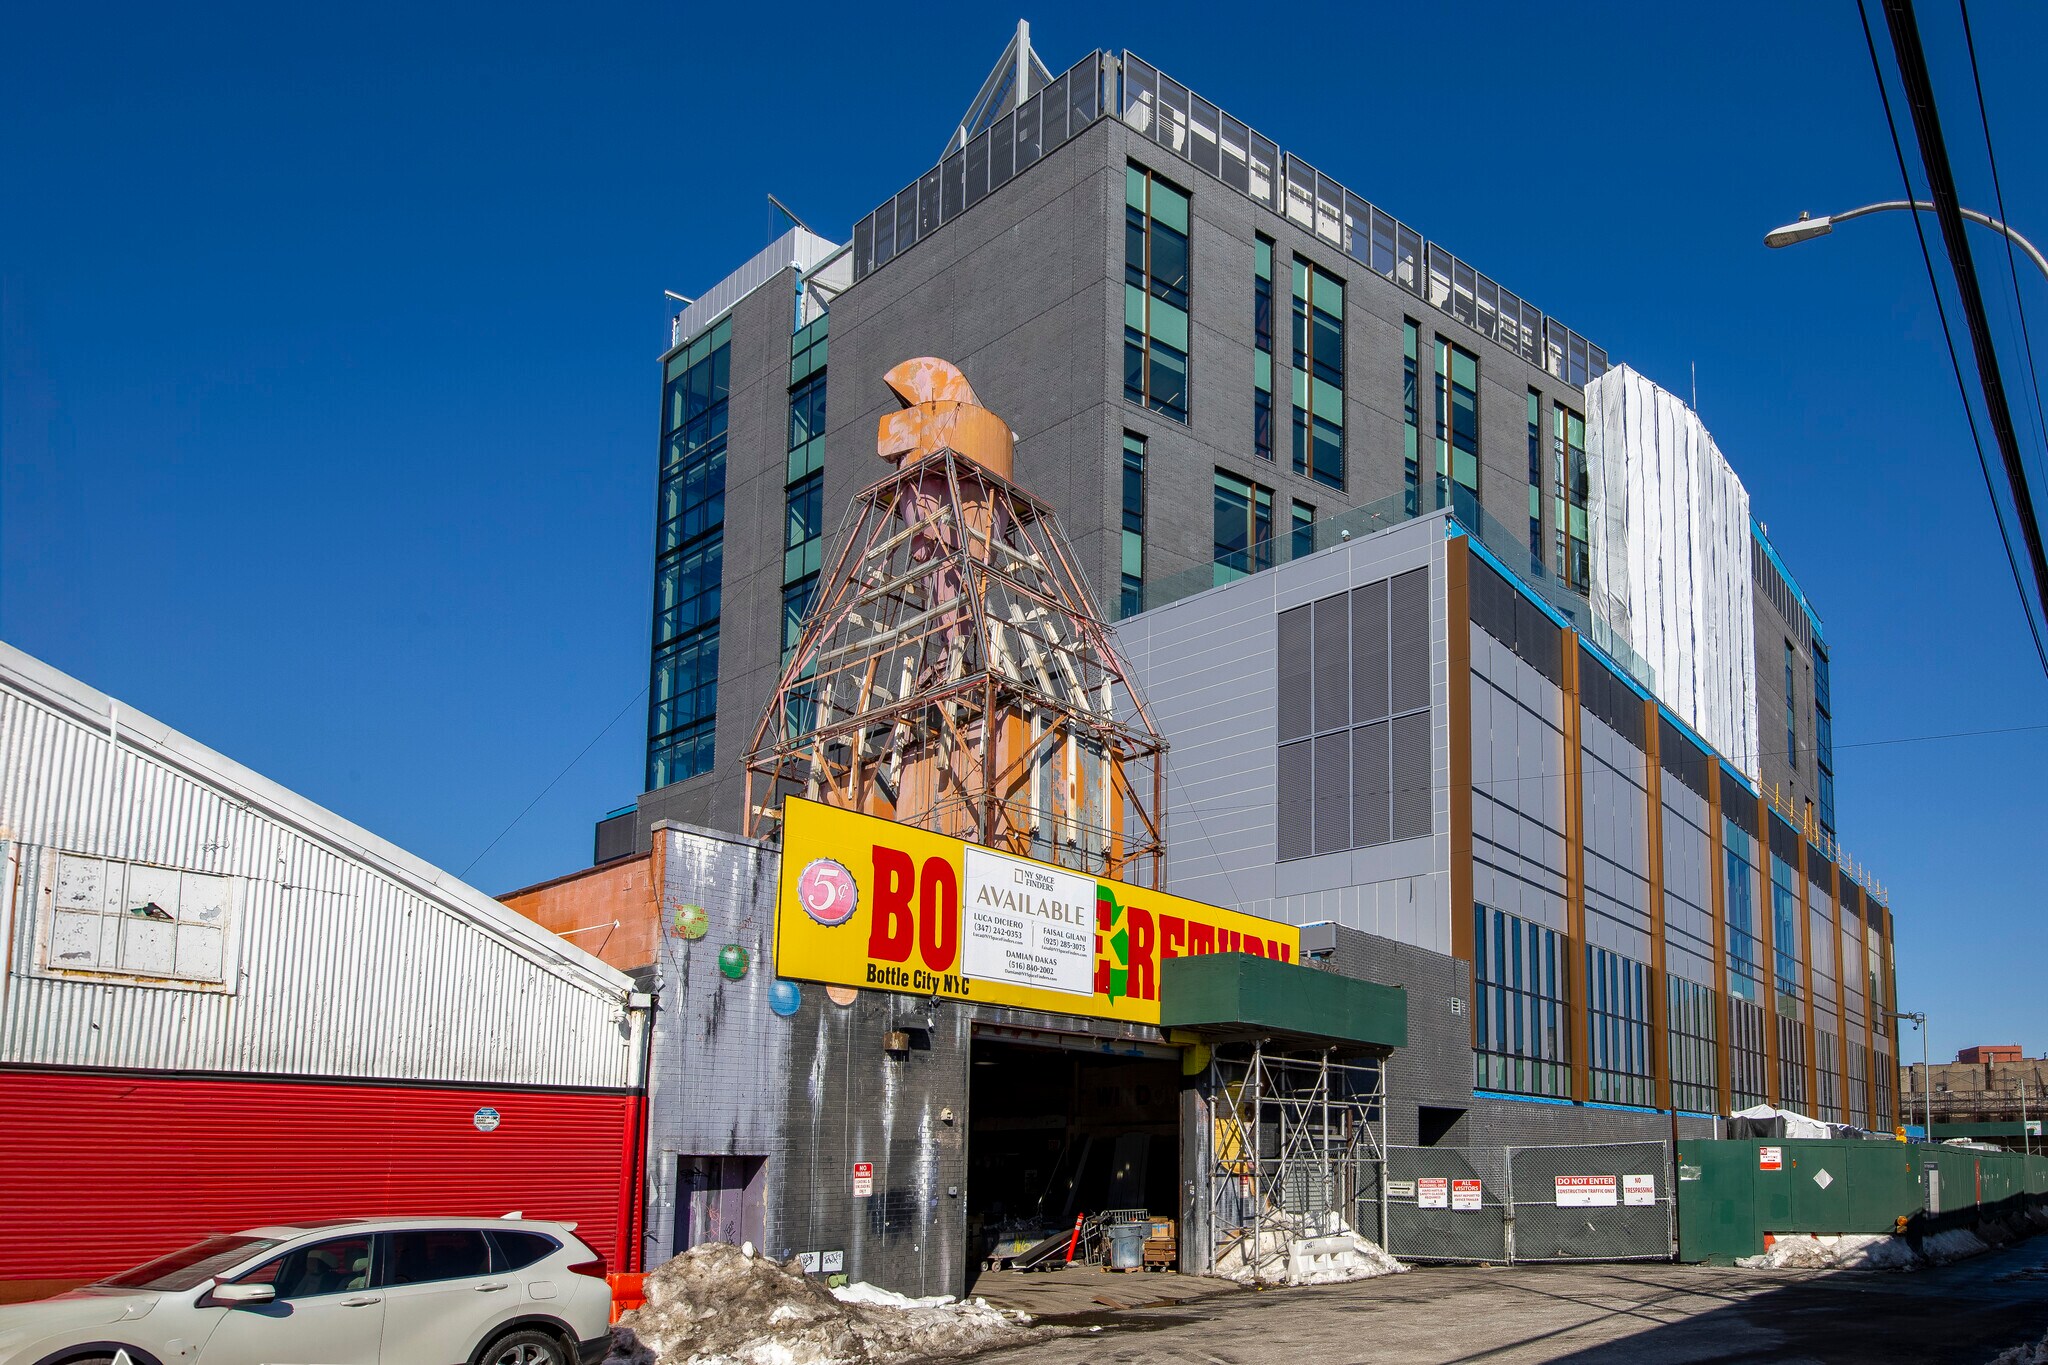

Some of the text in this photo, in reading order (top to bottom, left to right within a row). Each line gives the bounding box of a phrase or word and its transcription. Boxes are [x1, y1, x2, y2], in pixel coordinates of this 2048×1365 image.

[1024, 870, 1055, 885] NY SPACE
[1025, 879, 1054, 892] FINDERS
[976, 884, 1085, 926] AVAILABLE
[973, 912, 1024, 930] LUCA DICIERO
[974, 922, 1022, 939] (347) 242-0353
[1043, 927, 1087, 943] FAISAL GILANI
[1043, 936, 1086, 952] (925) 285-3075
[1006, 950, 1058, 966] DAMIAN DAKAS
[1008, 960, 1054, 975] (516) 840-2002
[866, 963, 970, 996] Bottle City NYC
[1589, 1177, 1614, 1185] ENTER
